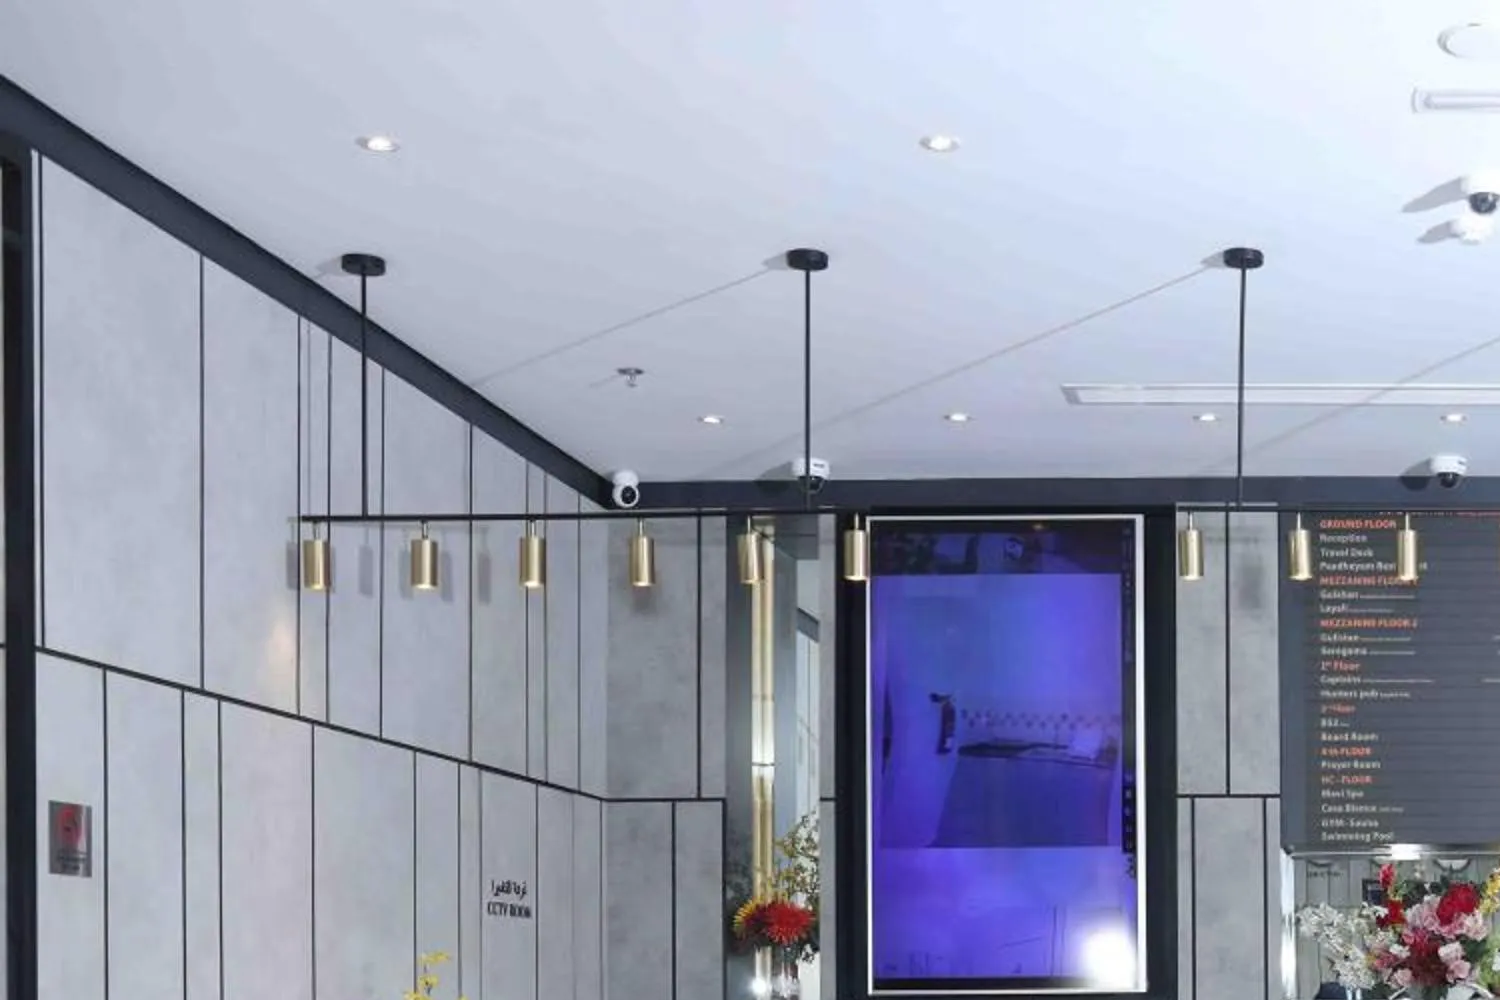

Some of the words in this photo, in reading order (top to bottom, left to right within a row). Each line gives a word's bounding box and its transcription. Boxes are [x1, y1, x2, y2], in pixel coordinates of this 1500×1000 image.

[1319, 519, 1364, 530] GROUND
[1365, 519, 1397, 530] FLOOR
[1319, 533, 1368, 545] Reception
[1320, 547, 1349, 558] Travel
[1350, 547, 1374, 558] Desk
[1319, 618, 1376, 629] MEZZANINE
[1377, 618, 1411, 629] FLOOR
[1333, 661, 1361, 671] Floor
[486, 901, 508, 917] CCTV
[509, 903, 532, 919] ROOM
